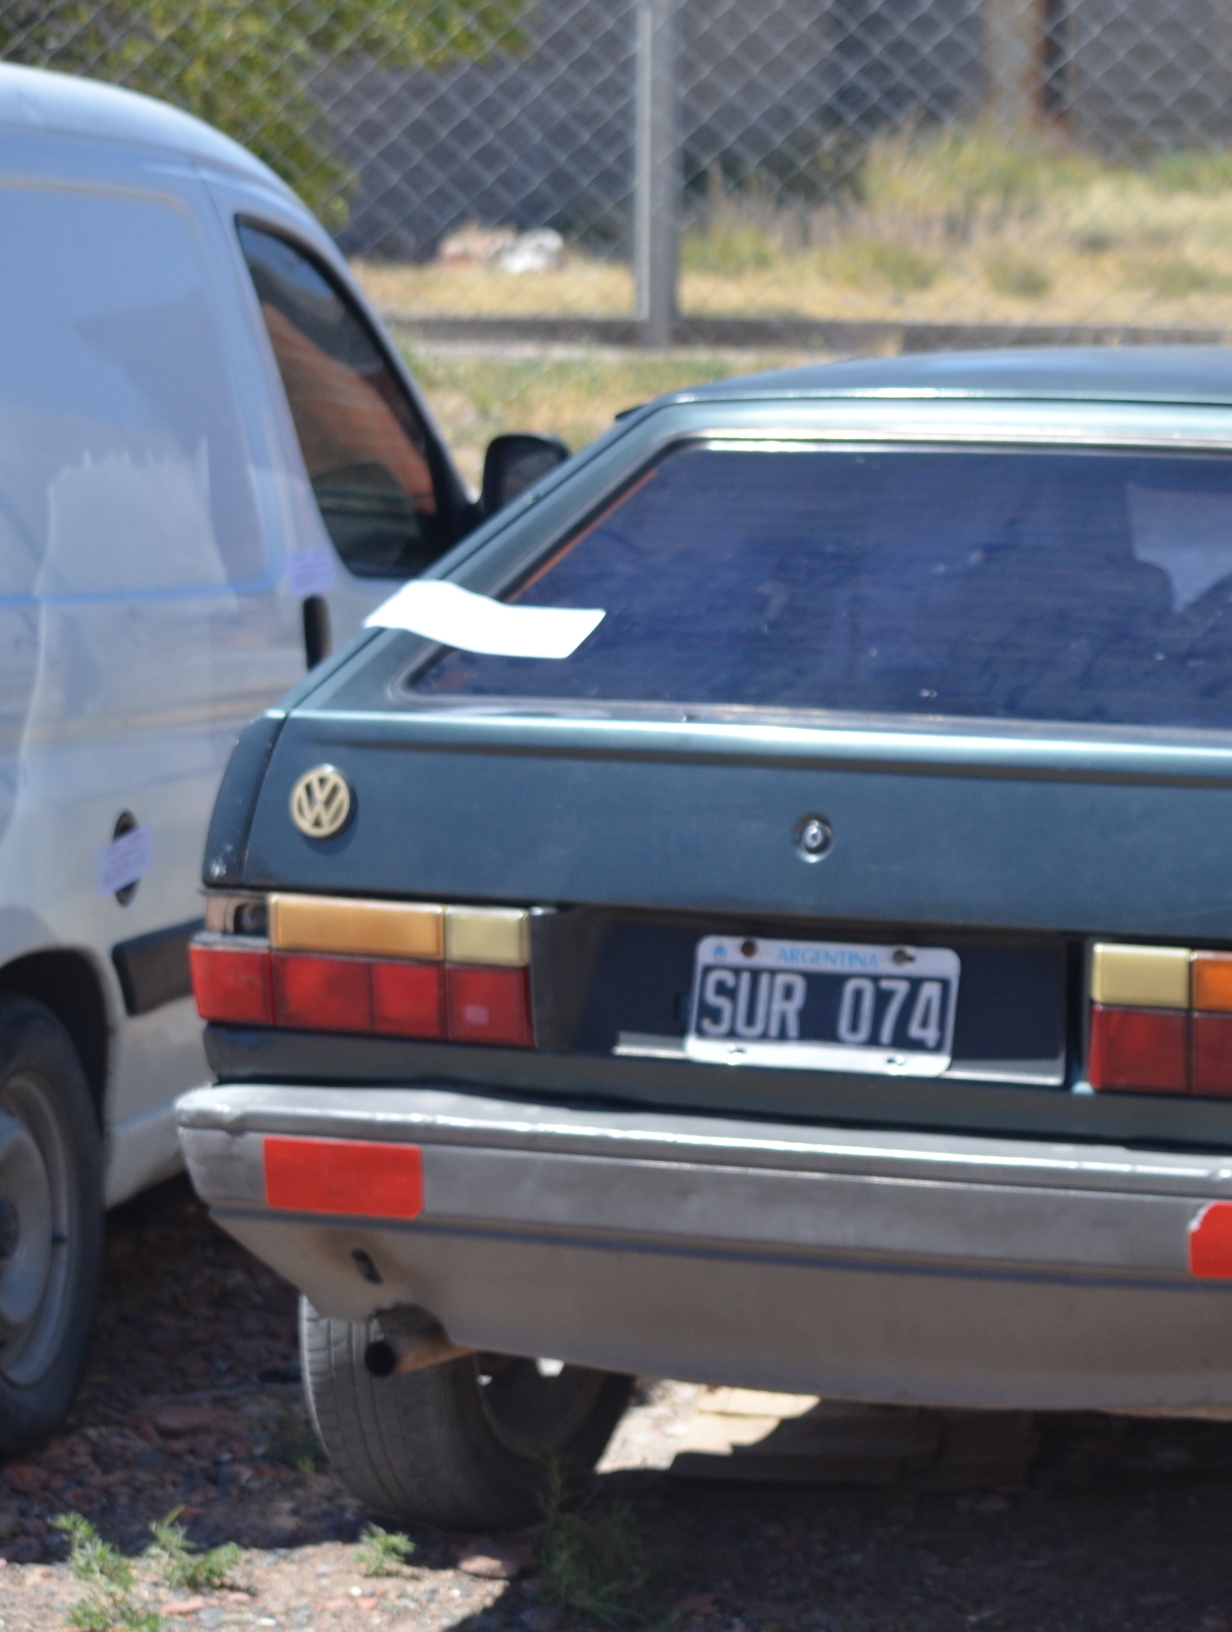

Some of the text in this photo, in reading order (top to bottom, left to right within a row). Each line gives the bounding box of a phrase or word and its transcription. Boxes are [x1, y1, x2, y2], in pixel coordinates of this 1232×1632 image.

[290, 764, 351, 838] VW
[776, 947, 880, 969] ARGENTINA
[702, 969, 942, 1048] SUR 074
